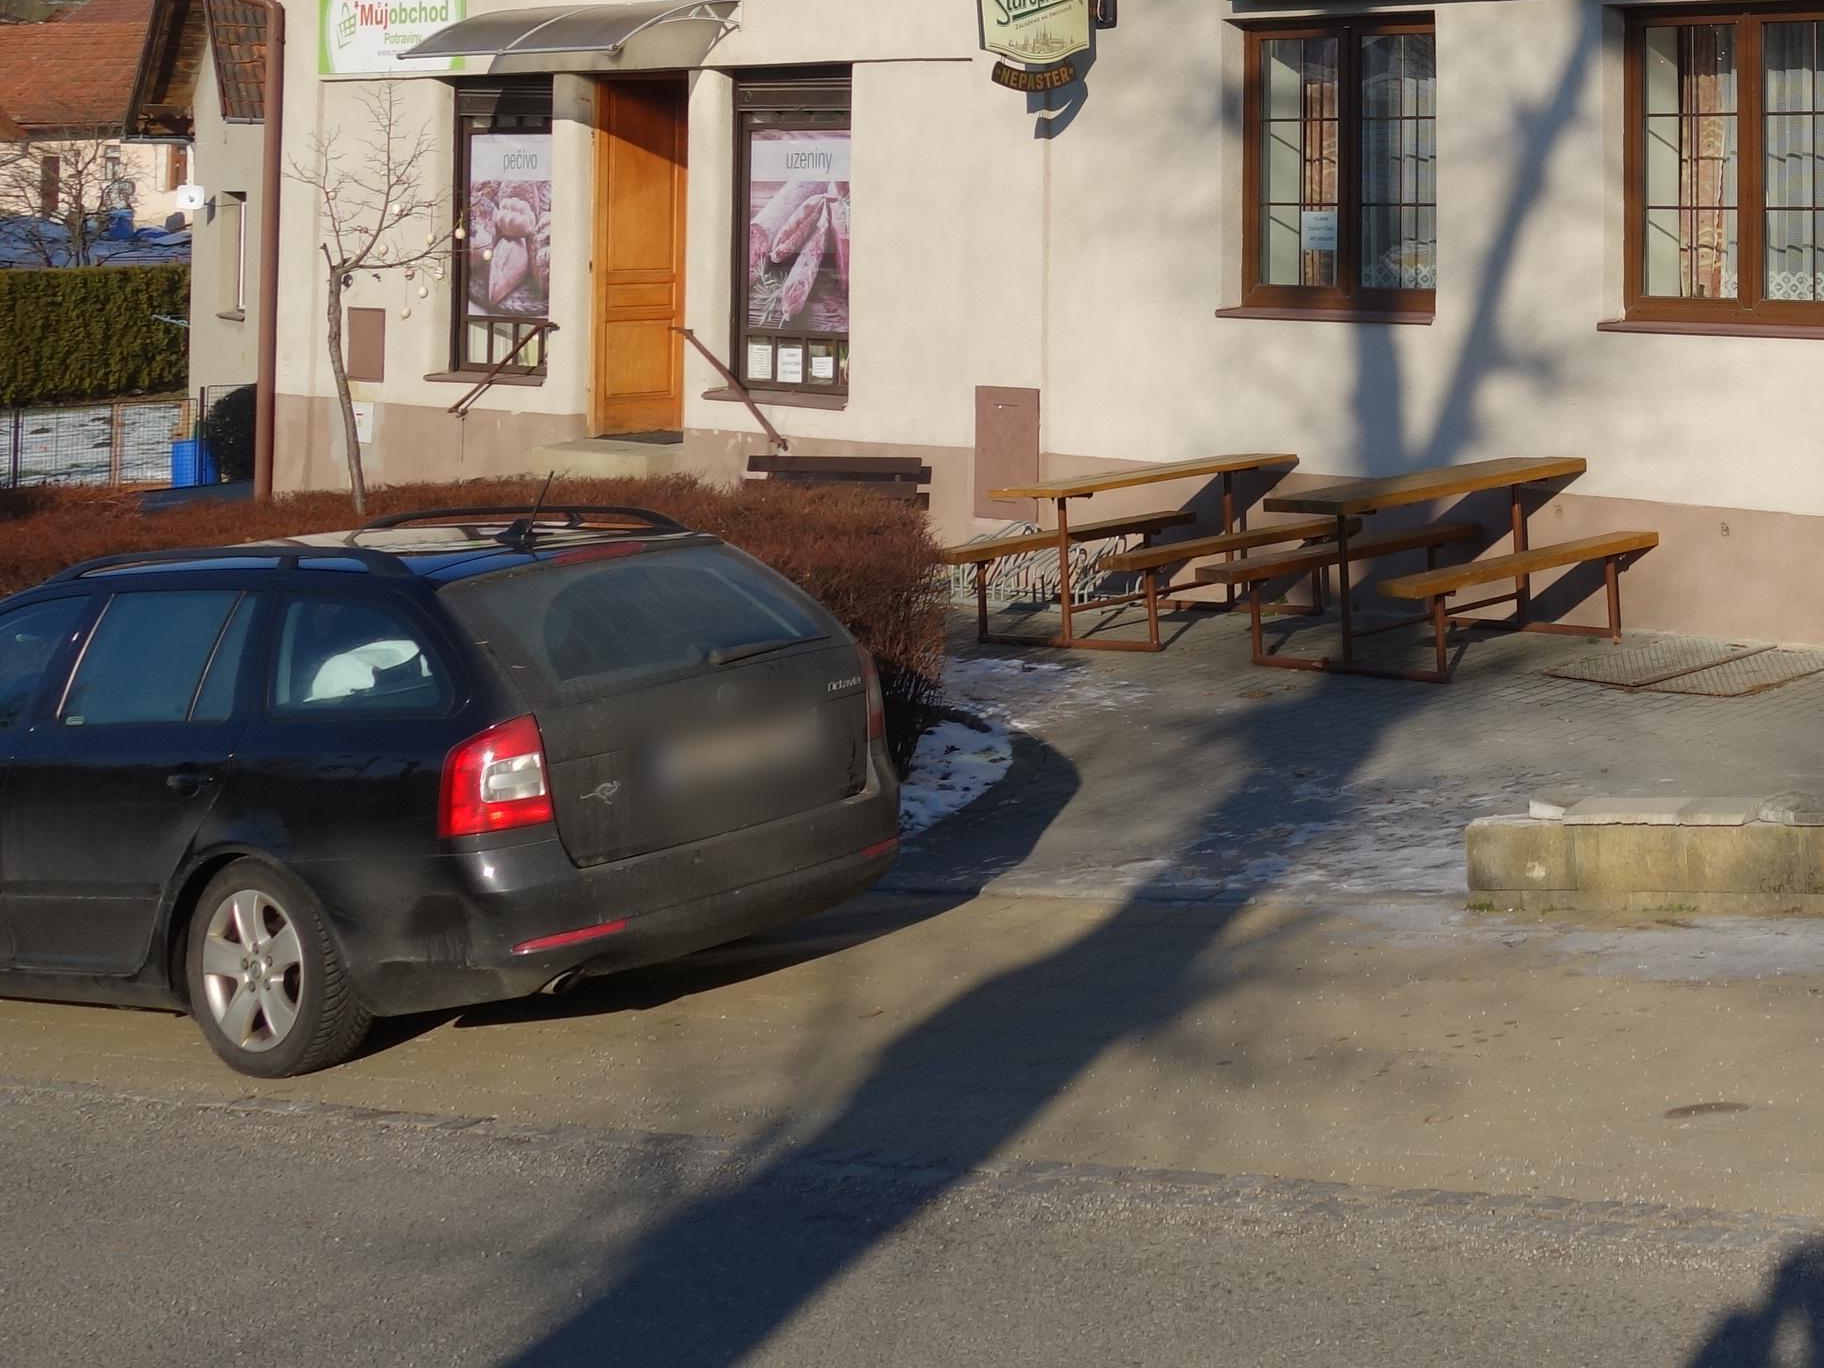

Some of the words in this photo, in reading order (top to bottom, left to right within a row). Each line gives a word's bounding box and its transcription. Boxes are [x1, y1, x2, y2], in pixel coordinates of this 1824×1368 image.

[1001, 66, 1071, 90] NEPASTER
[503, 149, 538, 173] pečivo
[786, 147, 833, 174] uzeniny
